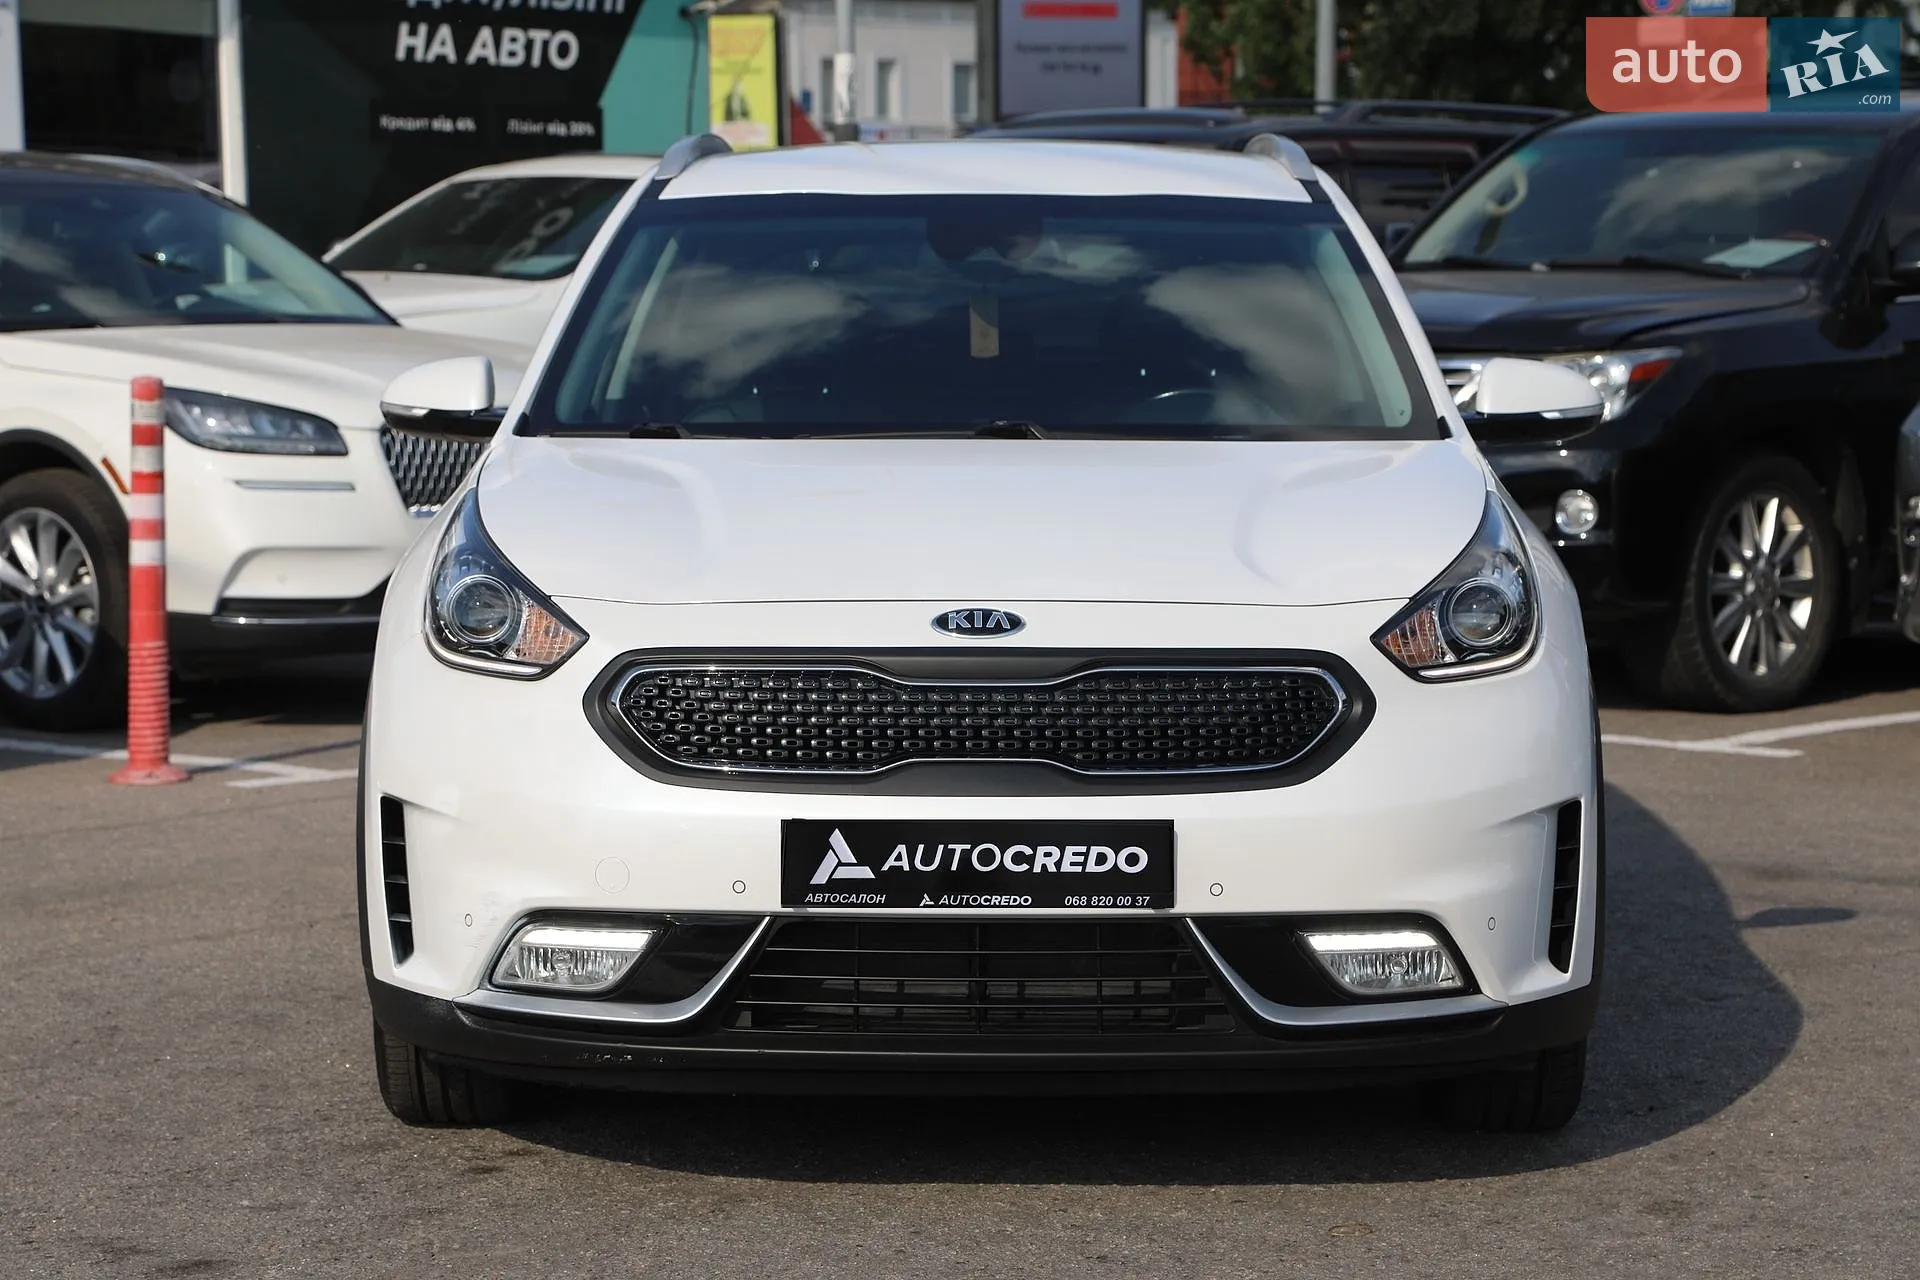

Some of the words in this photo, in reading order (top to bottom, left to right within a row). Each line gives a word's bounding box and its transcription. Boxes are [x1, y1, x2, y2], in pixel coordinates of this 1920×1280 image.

[395, 21, 457, 63] НА
[465, 25, 580, 70] АВТО
[948, 610, 1011, 629] KIA
[881, 843, 1149, 873] AUTOCREDO
[805, 893, 887, 904] АВТОСАЛОН
[939, 894, 1032, 906] AUTOCREDO
[1064, 896, 1087, 906] 068
[1091, 896, 1113, 906] 820
[1117, 896, 1132, 906] 00
[1135, 896, 1150, 906] 37
